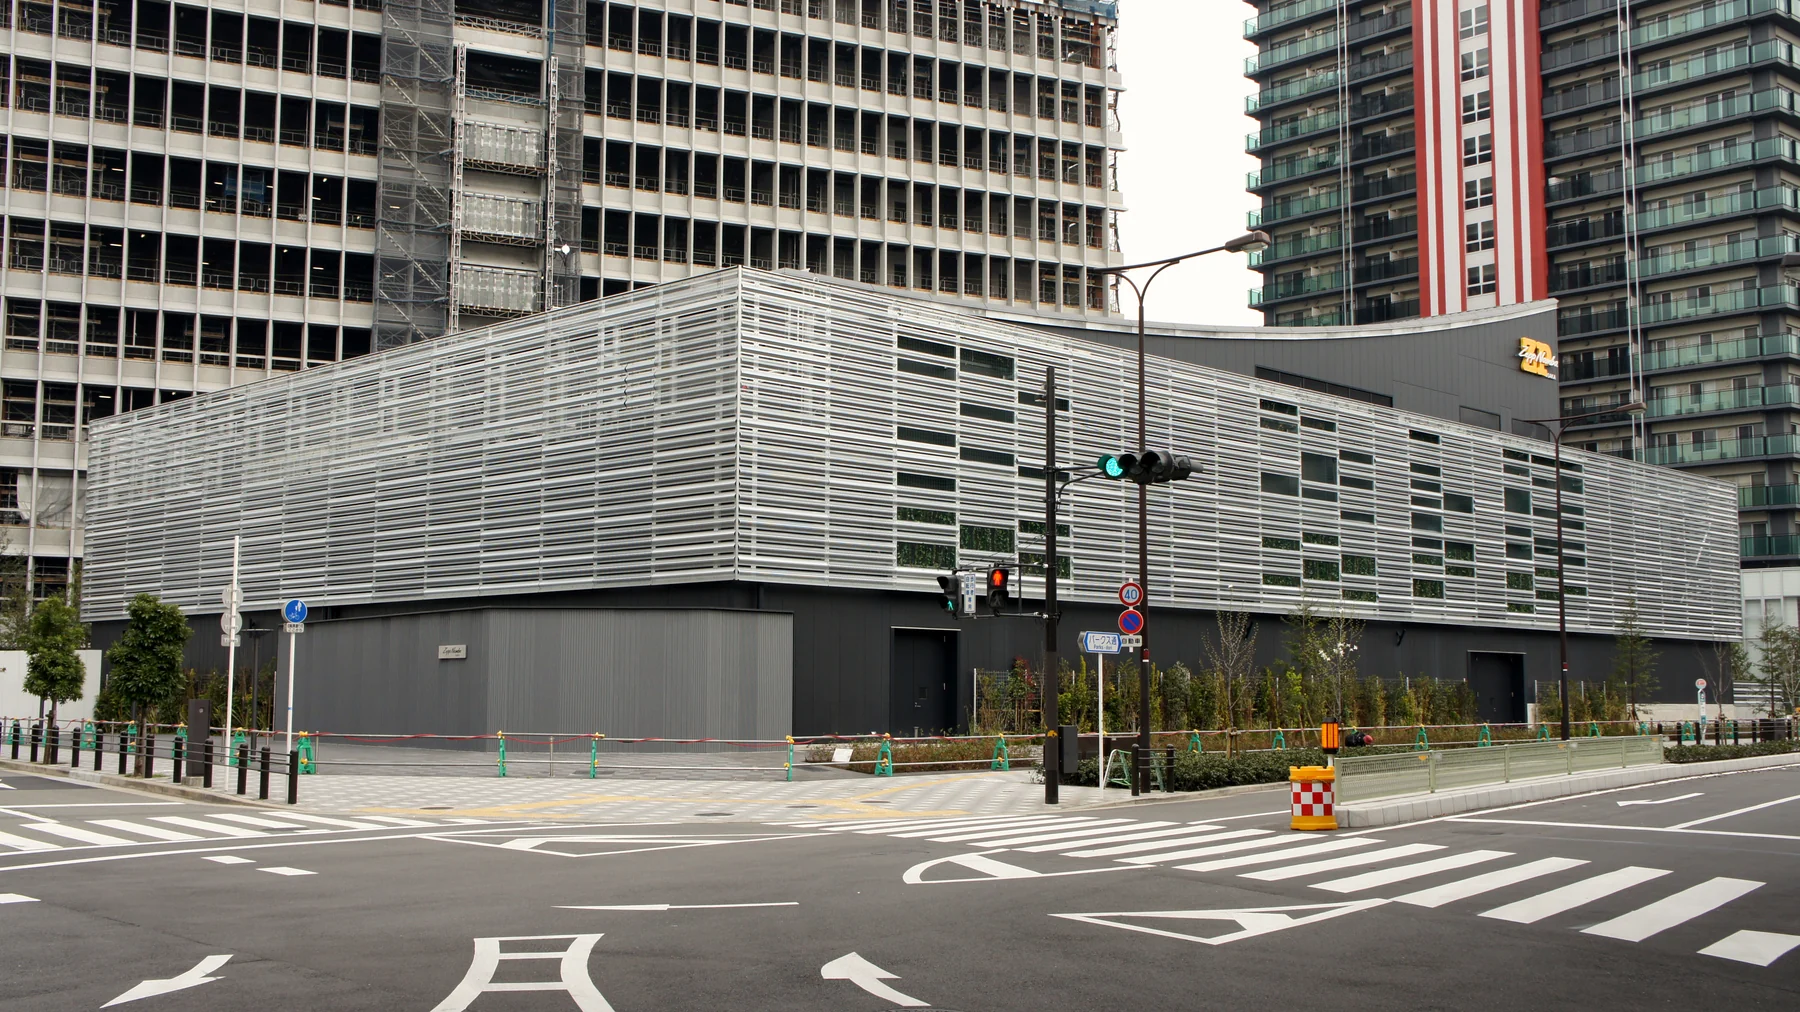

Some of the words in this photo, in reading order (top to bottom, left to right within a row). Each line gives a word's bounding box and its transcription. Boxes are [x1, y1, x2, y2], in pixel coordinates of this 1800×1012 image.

[1518, 345, 1537, 364] Zepp
[1535, 351, 1559, 368] Namba
[1124, 589, 1138, 600] 40
[1122, 637, 1141, 645] 自動車
